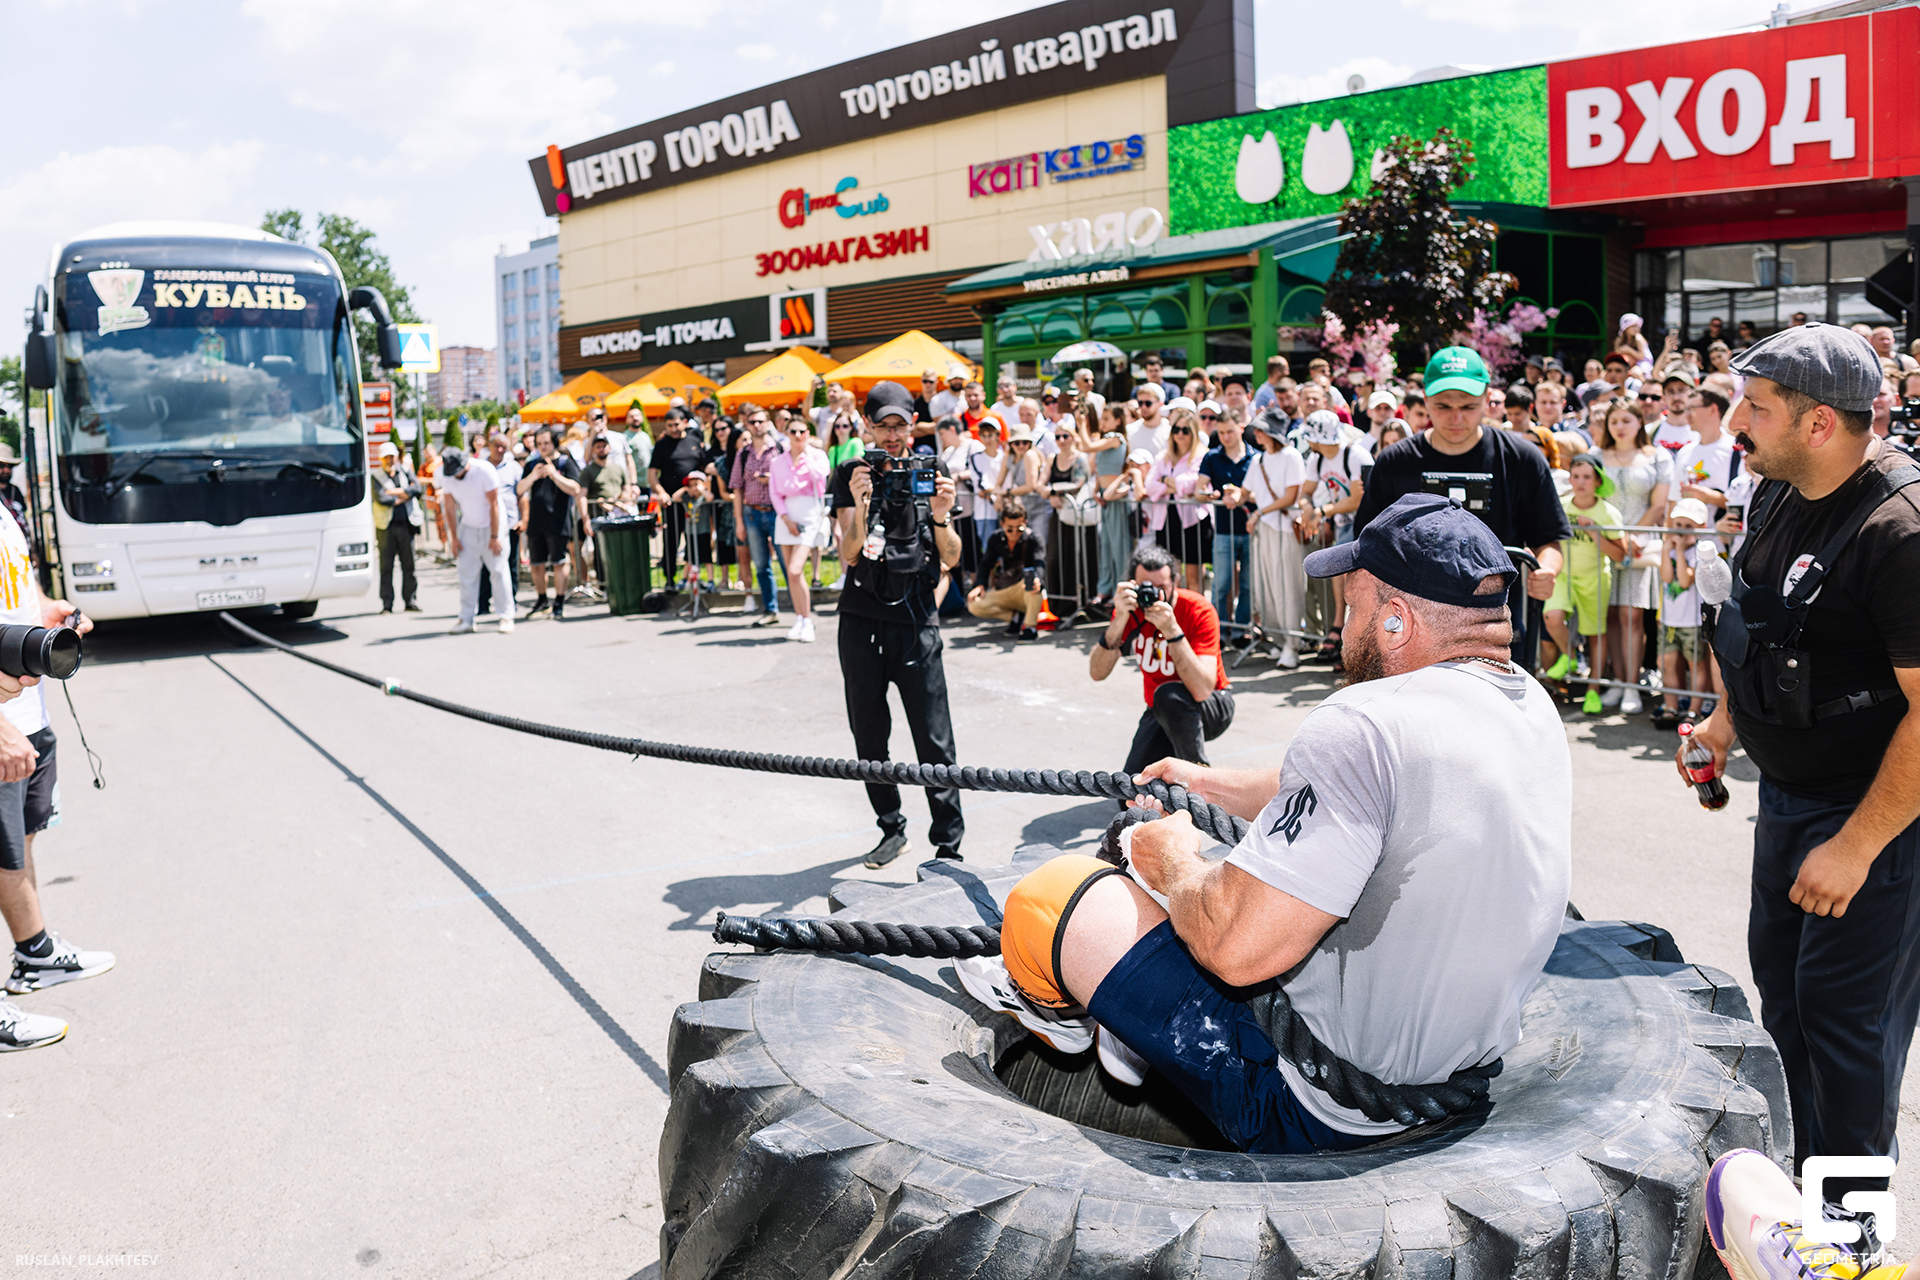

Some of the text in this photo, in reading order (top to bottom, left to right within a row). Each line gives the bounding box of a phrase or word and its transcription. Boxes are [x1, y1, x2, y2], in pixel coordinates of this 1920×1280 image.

[840, 8, 1178, 120] торговый квартал
[1565, 53, 1856, 169] ВХОД
[566, 140, 658, 200] ЦЕНТР
[663, 99, 801, 173] ГОРОДА
[755, 225, 930, 278] ЗООМАГАЗИН
[153, 269, 296, 285] ГАНДБОЛЬНЫЙ КЛУБ
[153, 282, 307, 311] КУБАНЬ
[1022, 265, 1129, 292] УНЕСЕННЫЕ АЗИЕЙ
[671, 316, 736, 346] ТОЧКА
